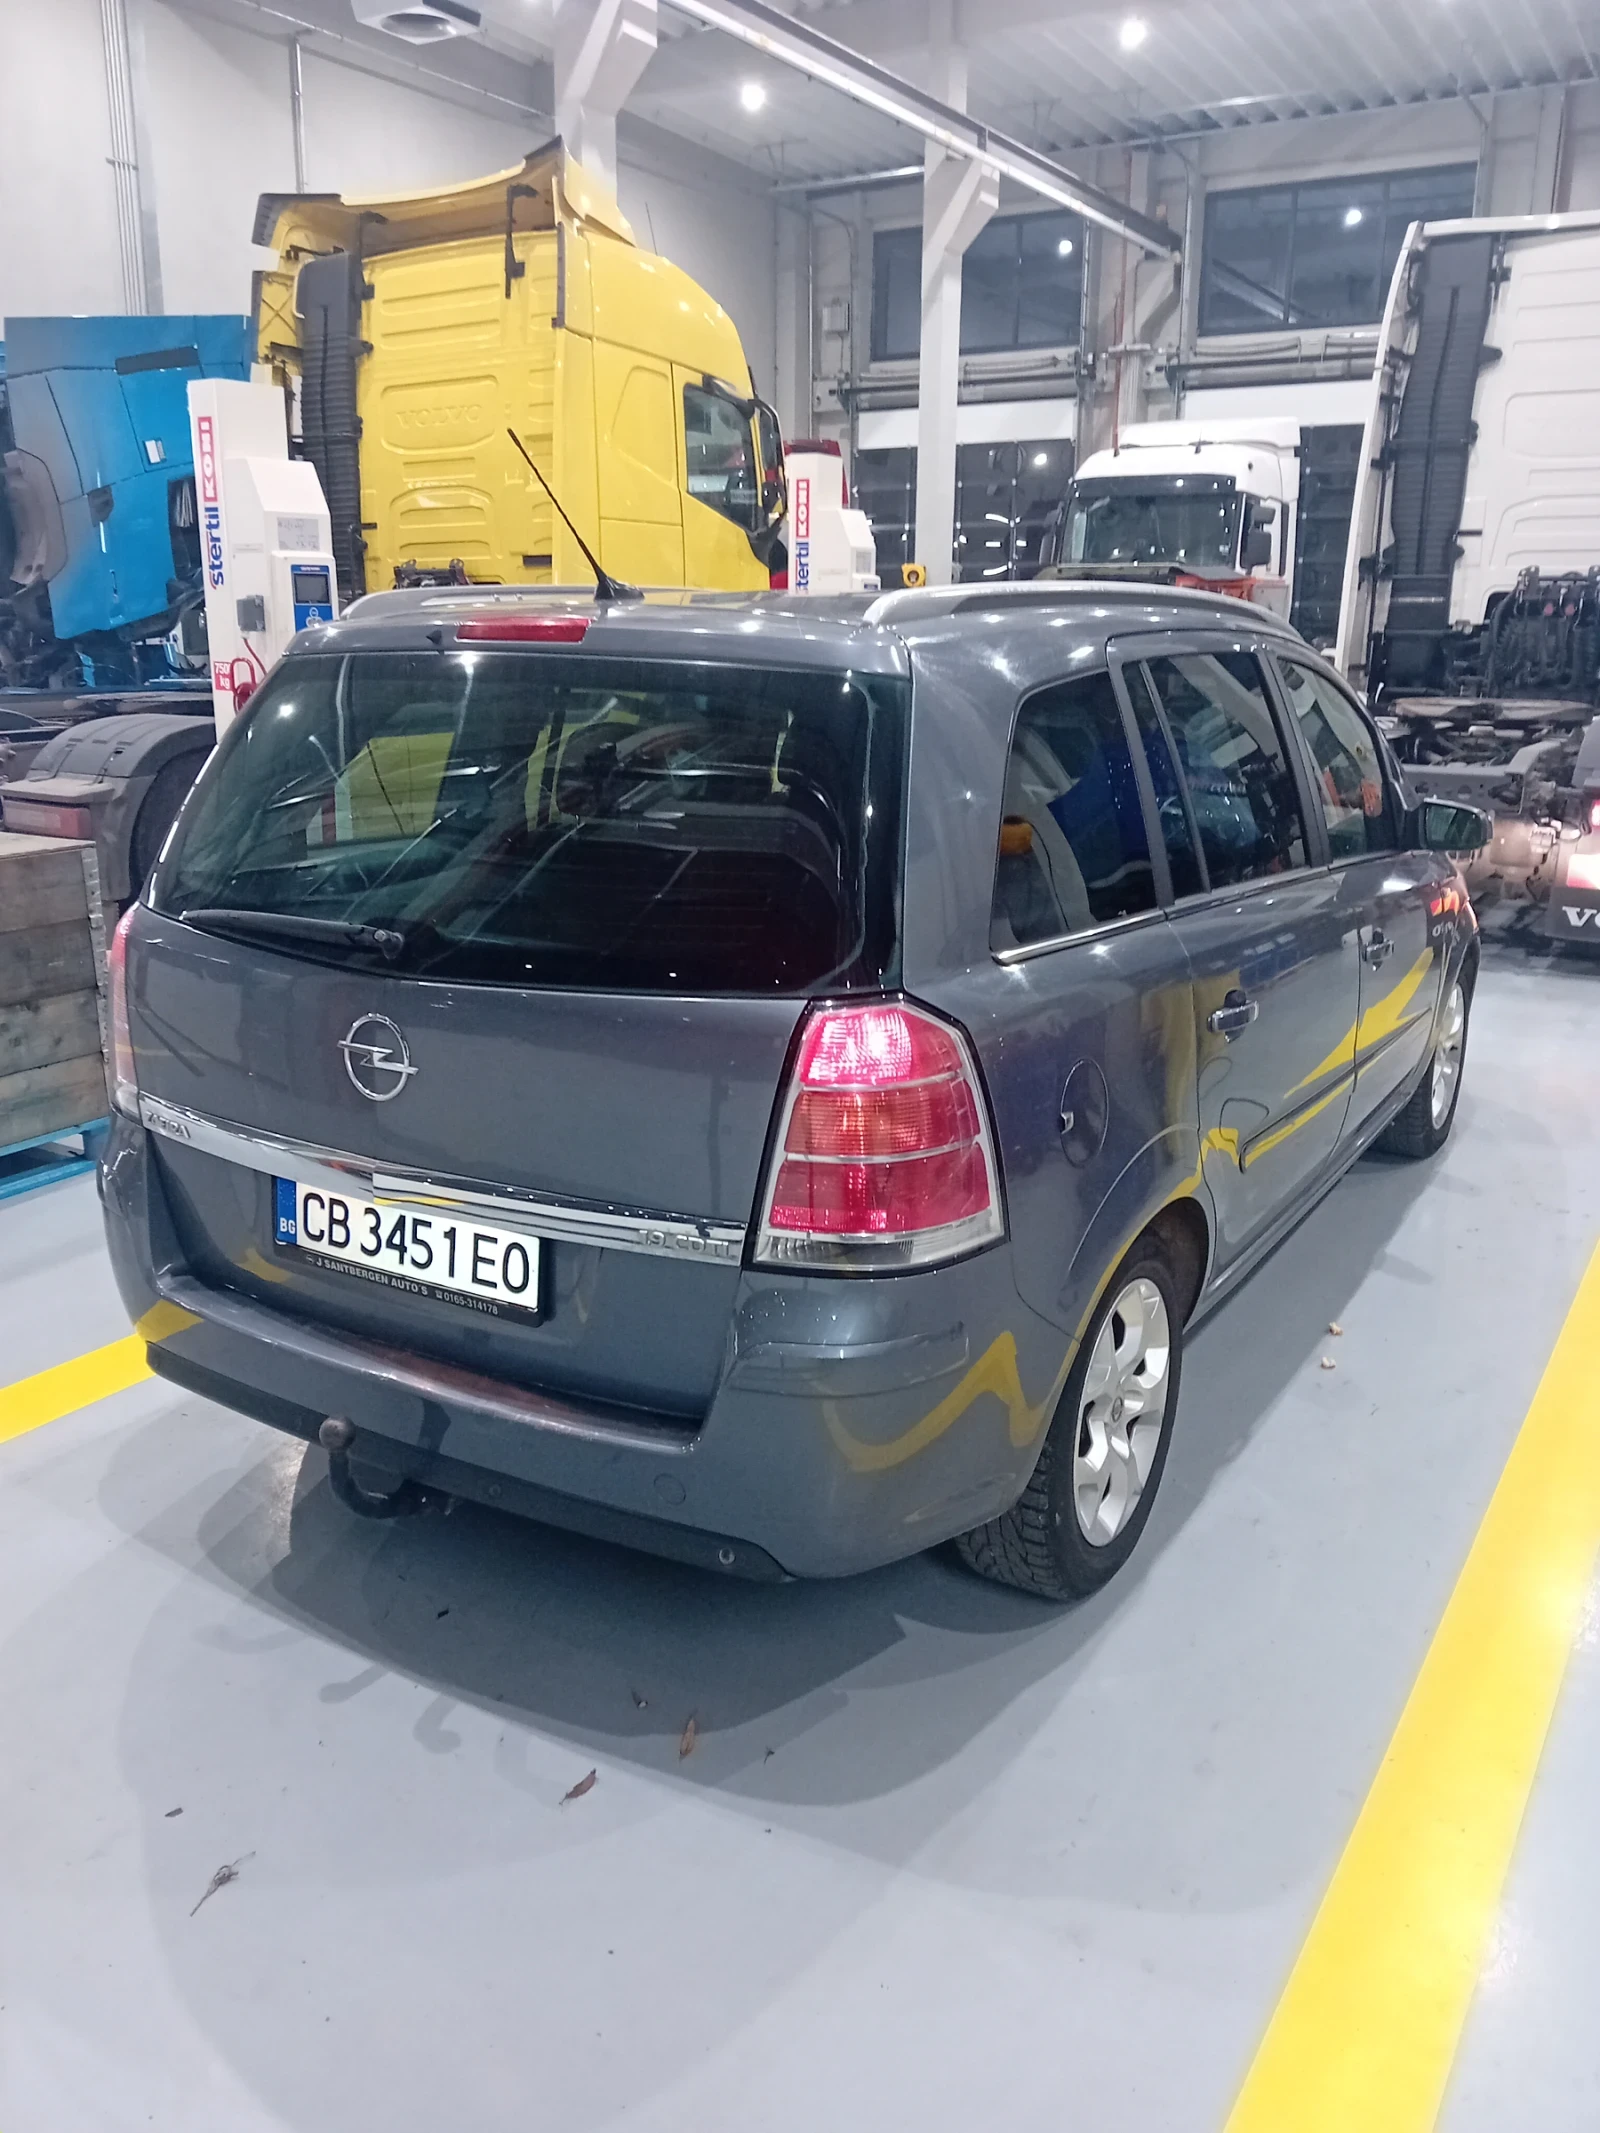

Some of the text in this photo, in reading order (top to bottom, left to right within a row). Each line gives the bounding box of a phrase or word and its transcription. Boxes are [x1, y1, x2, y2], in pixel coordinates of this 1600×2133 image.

[200, 421, 224, 590] stertil KONI
[797, 480, 809, 538] KONI
[214, 662, 231, 675] 750
[219, 675, 230, 690] kg
[280, 1217, 296, 1234] BG
[303, 1193, 350, 1248] CB
[360, 1207, 457, 1278] 3451
[324, 1259, 389, 1285] SANTBERGEN
[444, 1292, 499, 1315] 0165-314178
